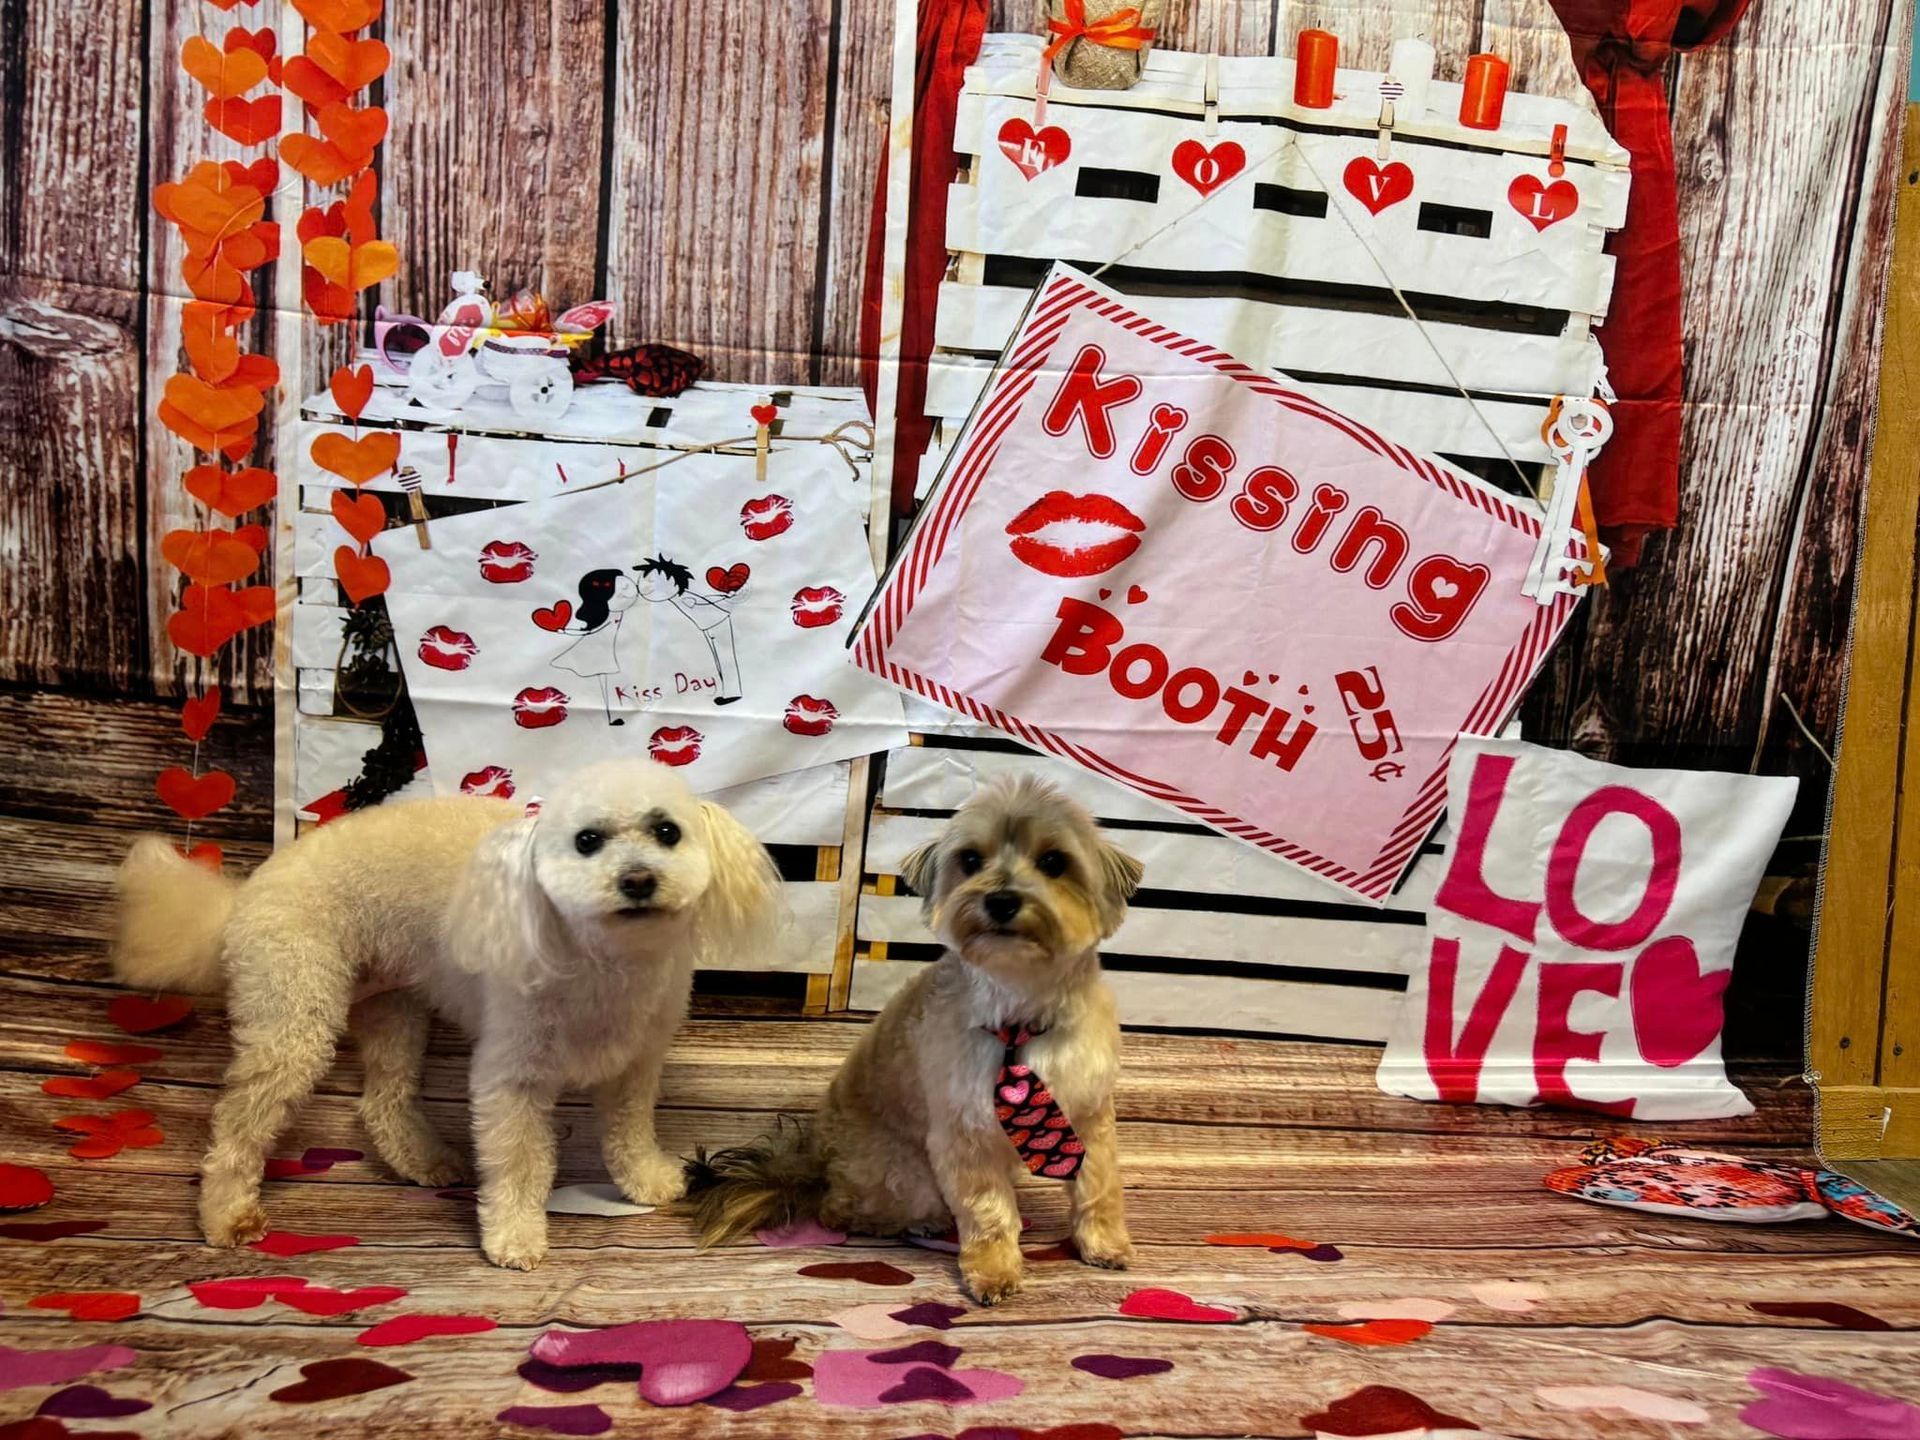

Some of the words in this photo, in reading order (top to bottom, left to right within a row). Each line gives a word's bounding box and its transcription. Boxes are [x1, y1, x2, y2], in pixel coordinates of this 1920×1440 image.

[1193, 158, 1220, 185] O
[1366, 173, 1392, 203] V
[1528, 191, 1556, 221] L
[1042, 344, 1490, 642] Kissing
[615, 685, 663, 706] Kiss
[674, 672, 718, 697] Day
[1040, 597, 1318, 773] BOOTH
[1434, 753, 1682, 952] LO
